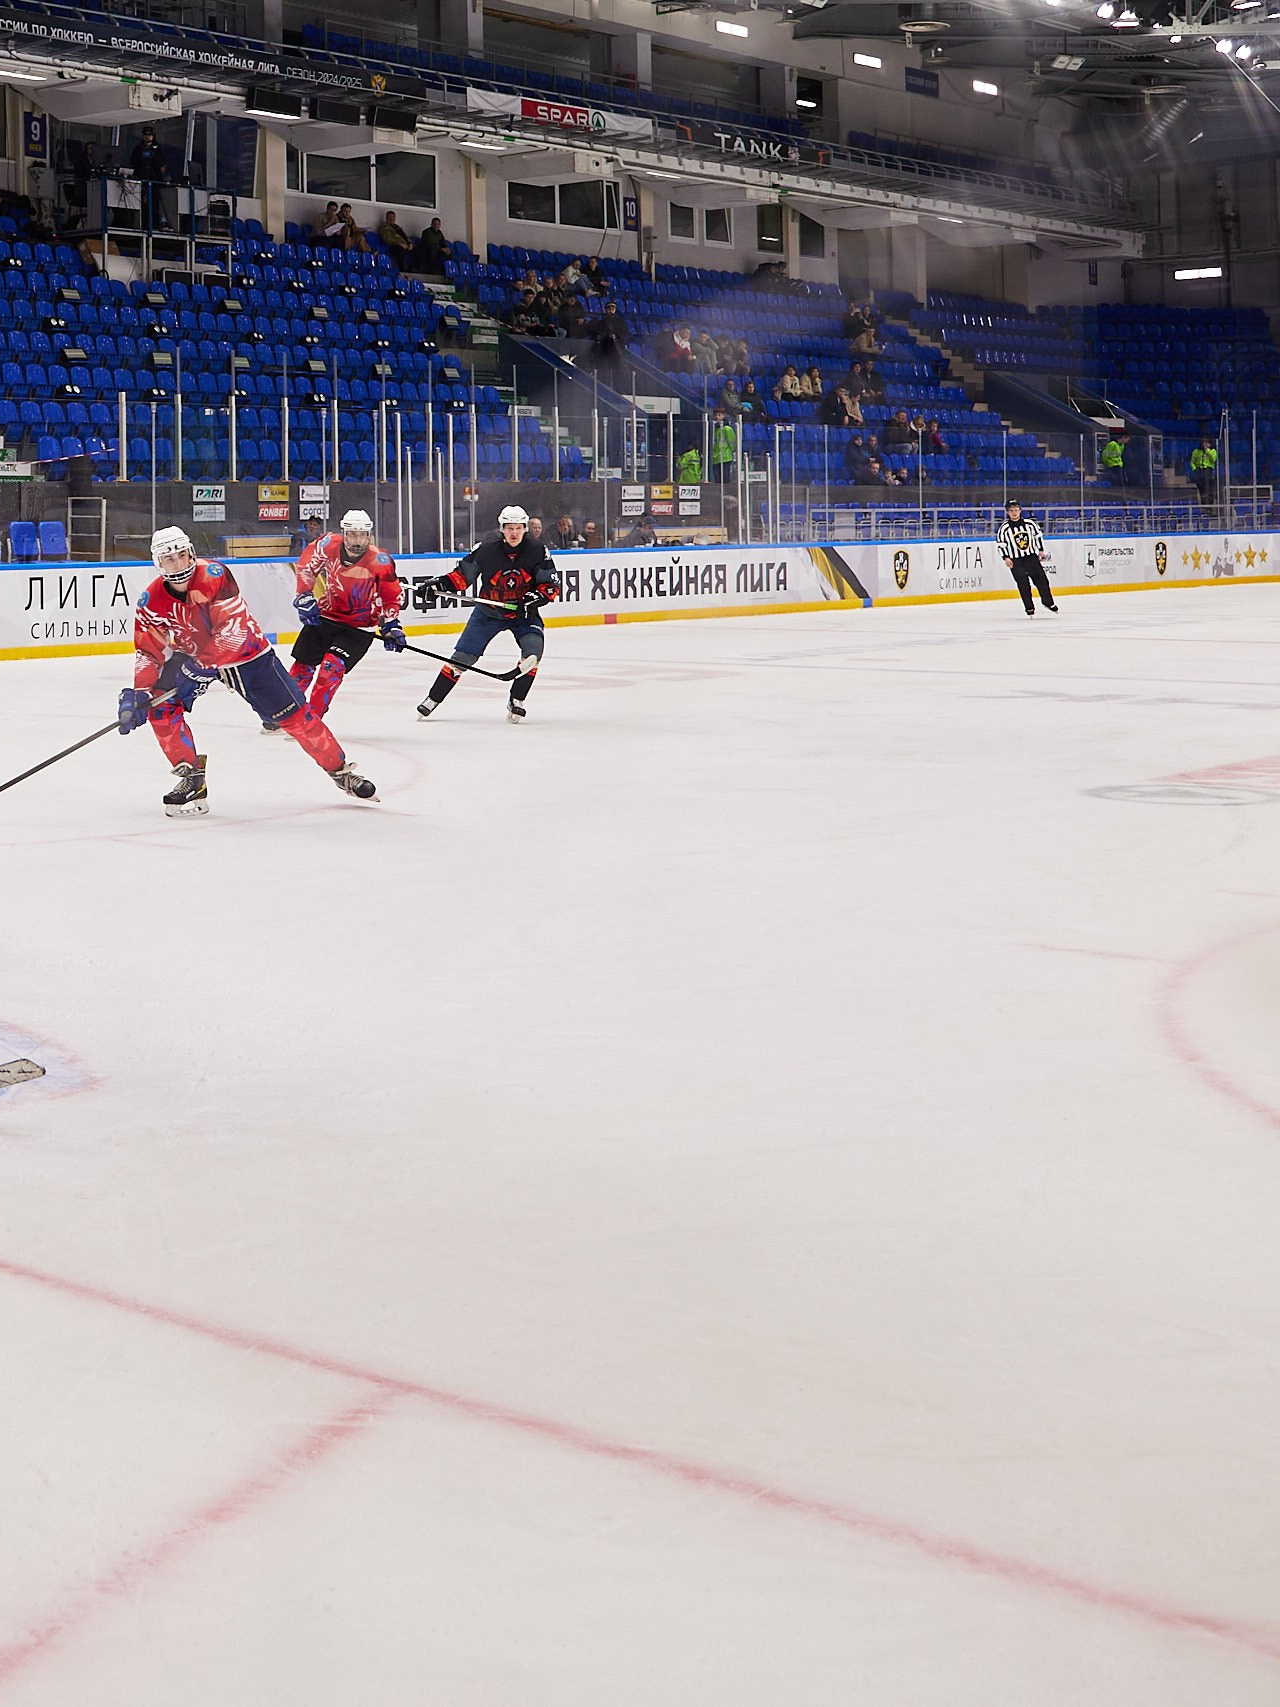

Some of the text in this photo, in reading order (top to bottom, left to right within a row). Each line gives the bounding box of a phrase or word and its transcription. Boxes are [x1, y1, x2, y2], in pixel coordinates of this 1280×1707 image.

[31, 24, 47, 36] ПО
[50, 27, 94, 43] ХОККЕЮ
[111, 36, 196, 60] ВСЕРОССИЙСКАЯ
[257, 62, 280, 74] ЛИГА
[286, 66, 315, 80] СЕЗОН
[317, 71, 363, 88] 2024/2025
[537, 105, 589, 127] SPAR
[30, 120, 41, 142] 9
[713, 132, 784, 163] TANK
[625, 201, 636, 217] 10
[259, 507, 289, 517] FONBET
[937, 546, 983, 570] ЛИГА
[590, 556, 727, 600] ХОККЕЙНАЯ
[735, 562, 788, 594] ЛИГА
[940, 576, 983, 590] СИЛЬНЫХ
[25, 573, 130, 611] ЛИГА
[30, 618, 129, 640] СИЛЬНЫХ
[272, 702, 296, 719] EASTON
